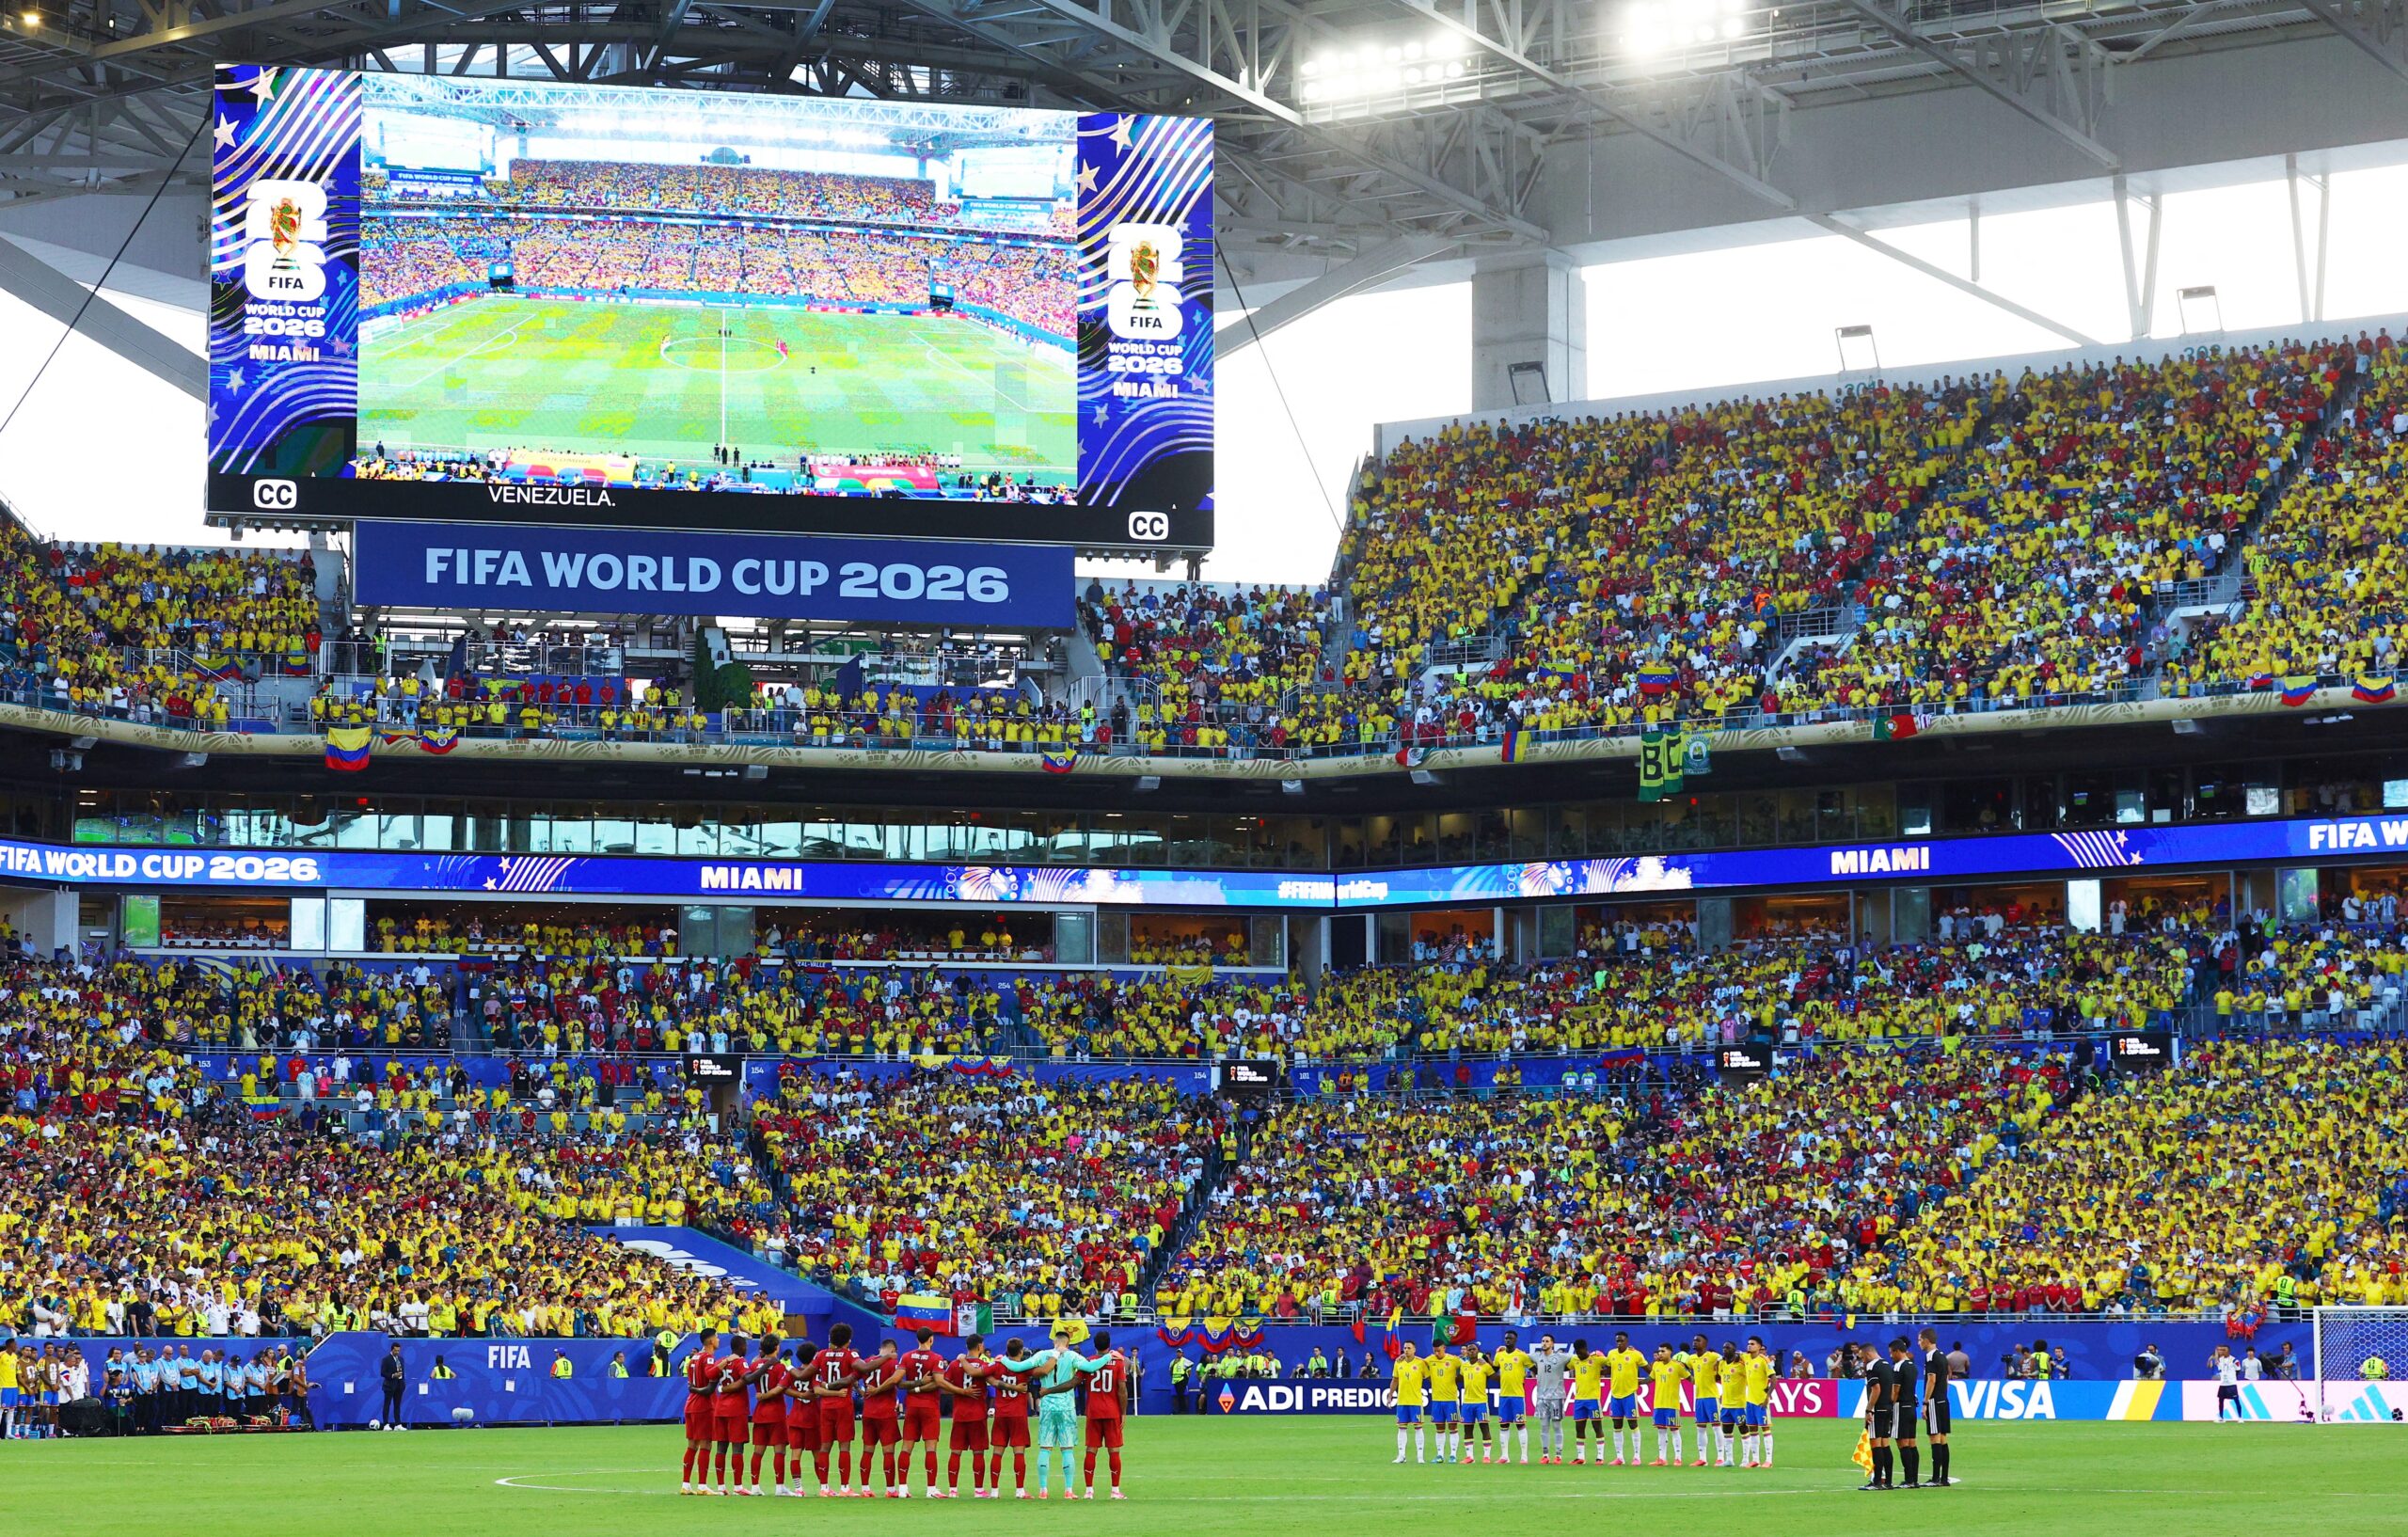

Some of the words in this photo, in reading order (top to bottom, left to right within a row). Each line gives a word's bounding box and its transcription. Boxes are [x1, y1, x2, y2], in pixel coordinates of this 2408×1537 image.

[269, 277, 304, 290] FIFA
[245, 304, 295, 317] WORLD
[297, 307, 325, 318] CUP
[1131, 316, 1163, 328] FIFA
[244, 317, 325, 337] 2026
[248, 344, 320, 361] MIAMI
[1108, 342, 1155, 356] WORLD
[1157, 344, 1183, 356] CUP
[1108, 356, 1183, 374] 2026
[1113, 382, 1179, 398] MIAMI
[258, 483, 292, 505] CC
[488, 485, 616, 506] VENEZUELA.
[1133, 515, 1164, 536] CC
[425, 547, 532, 587] FIFA
[540, 551, 721, 593] WORLD
[732, 559, 830, 596] CUP
[838, 562, 1009, 603] 2026
[2309, 822, 2378, 849] FIFA
[0, 847, 42, 873] FIFA
[45, 850, 137, 878] WORLD
[141, 854, 204, 879] CUP
[209, 856, 318, 881] 2026
[1830, 847, 1930, 875] MIAMI
[701, 865, 802, 890] MIAMI
[488, 1345, 531, 1369] FIFA
[1504, 1363, 1513, 1371] 23
[690, 1364, 696, 1386] 7
[827, 1362, 841, 1386] 13
[1090, 1370, 1113, 1392] 20
[1240, 1386, 1304, 1410] ADI
[1948, 1381, 2056, 1419] VISA
